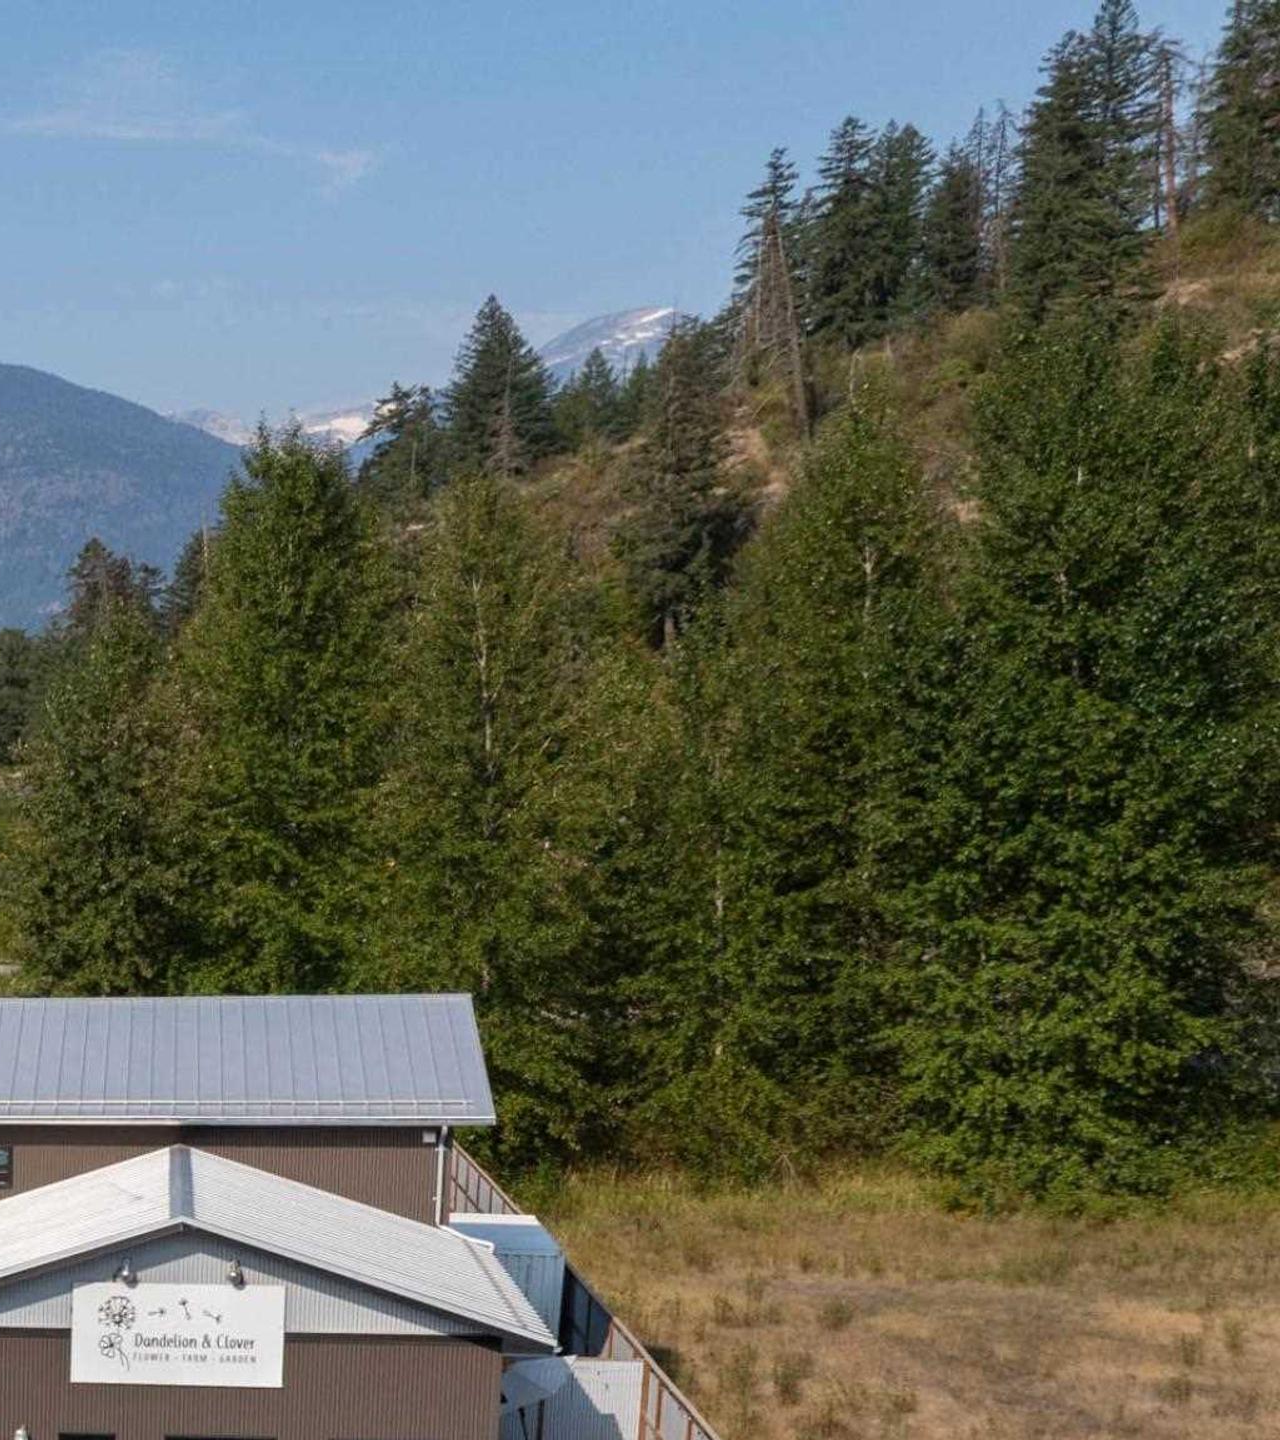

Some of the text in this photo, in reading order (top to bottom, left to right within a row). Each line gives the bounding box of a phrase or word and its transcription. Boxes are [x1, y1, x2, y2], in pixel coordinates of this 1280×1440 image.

[134, 1332, 255, 1350] Dandelion & Clover
[132, 1353, 257, 1364] FLOWER FARM GARDEN
